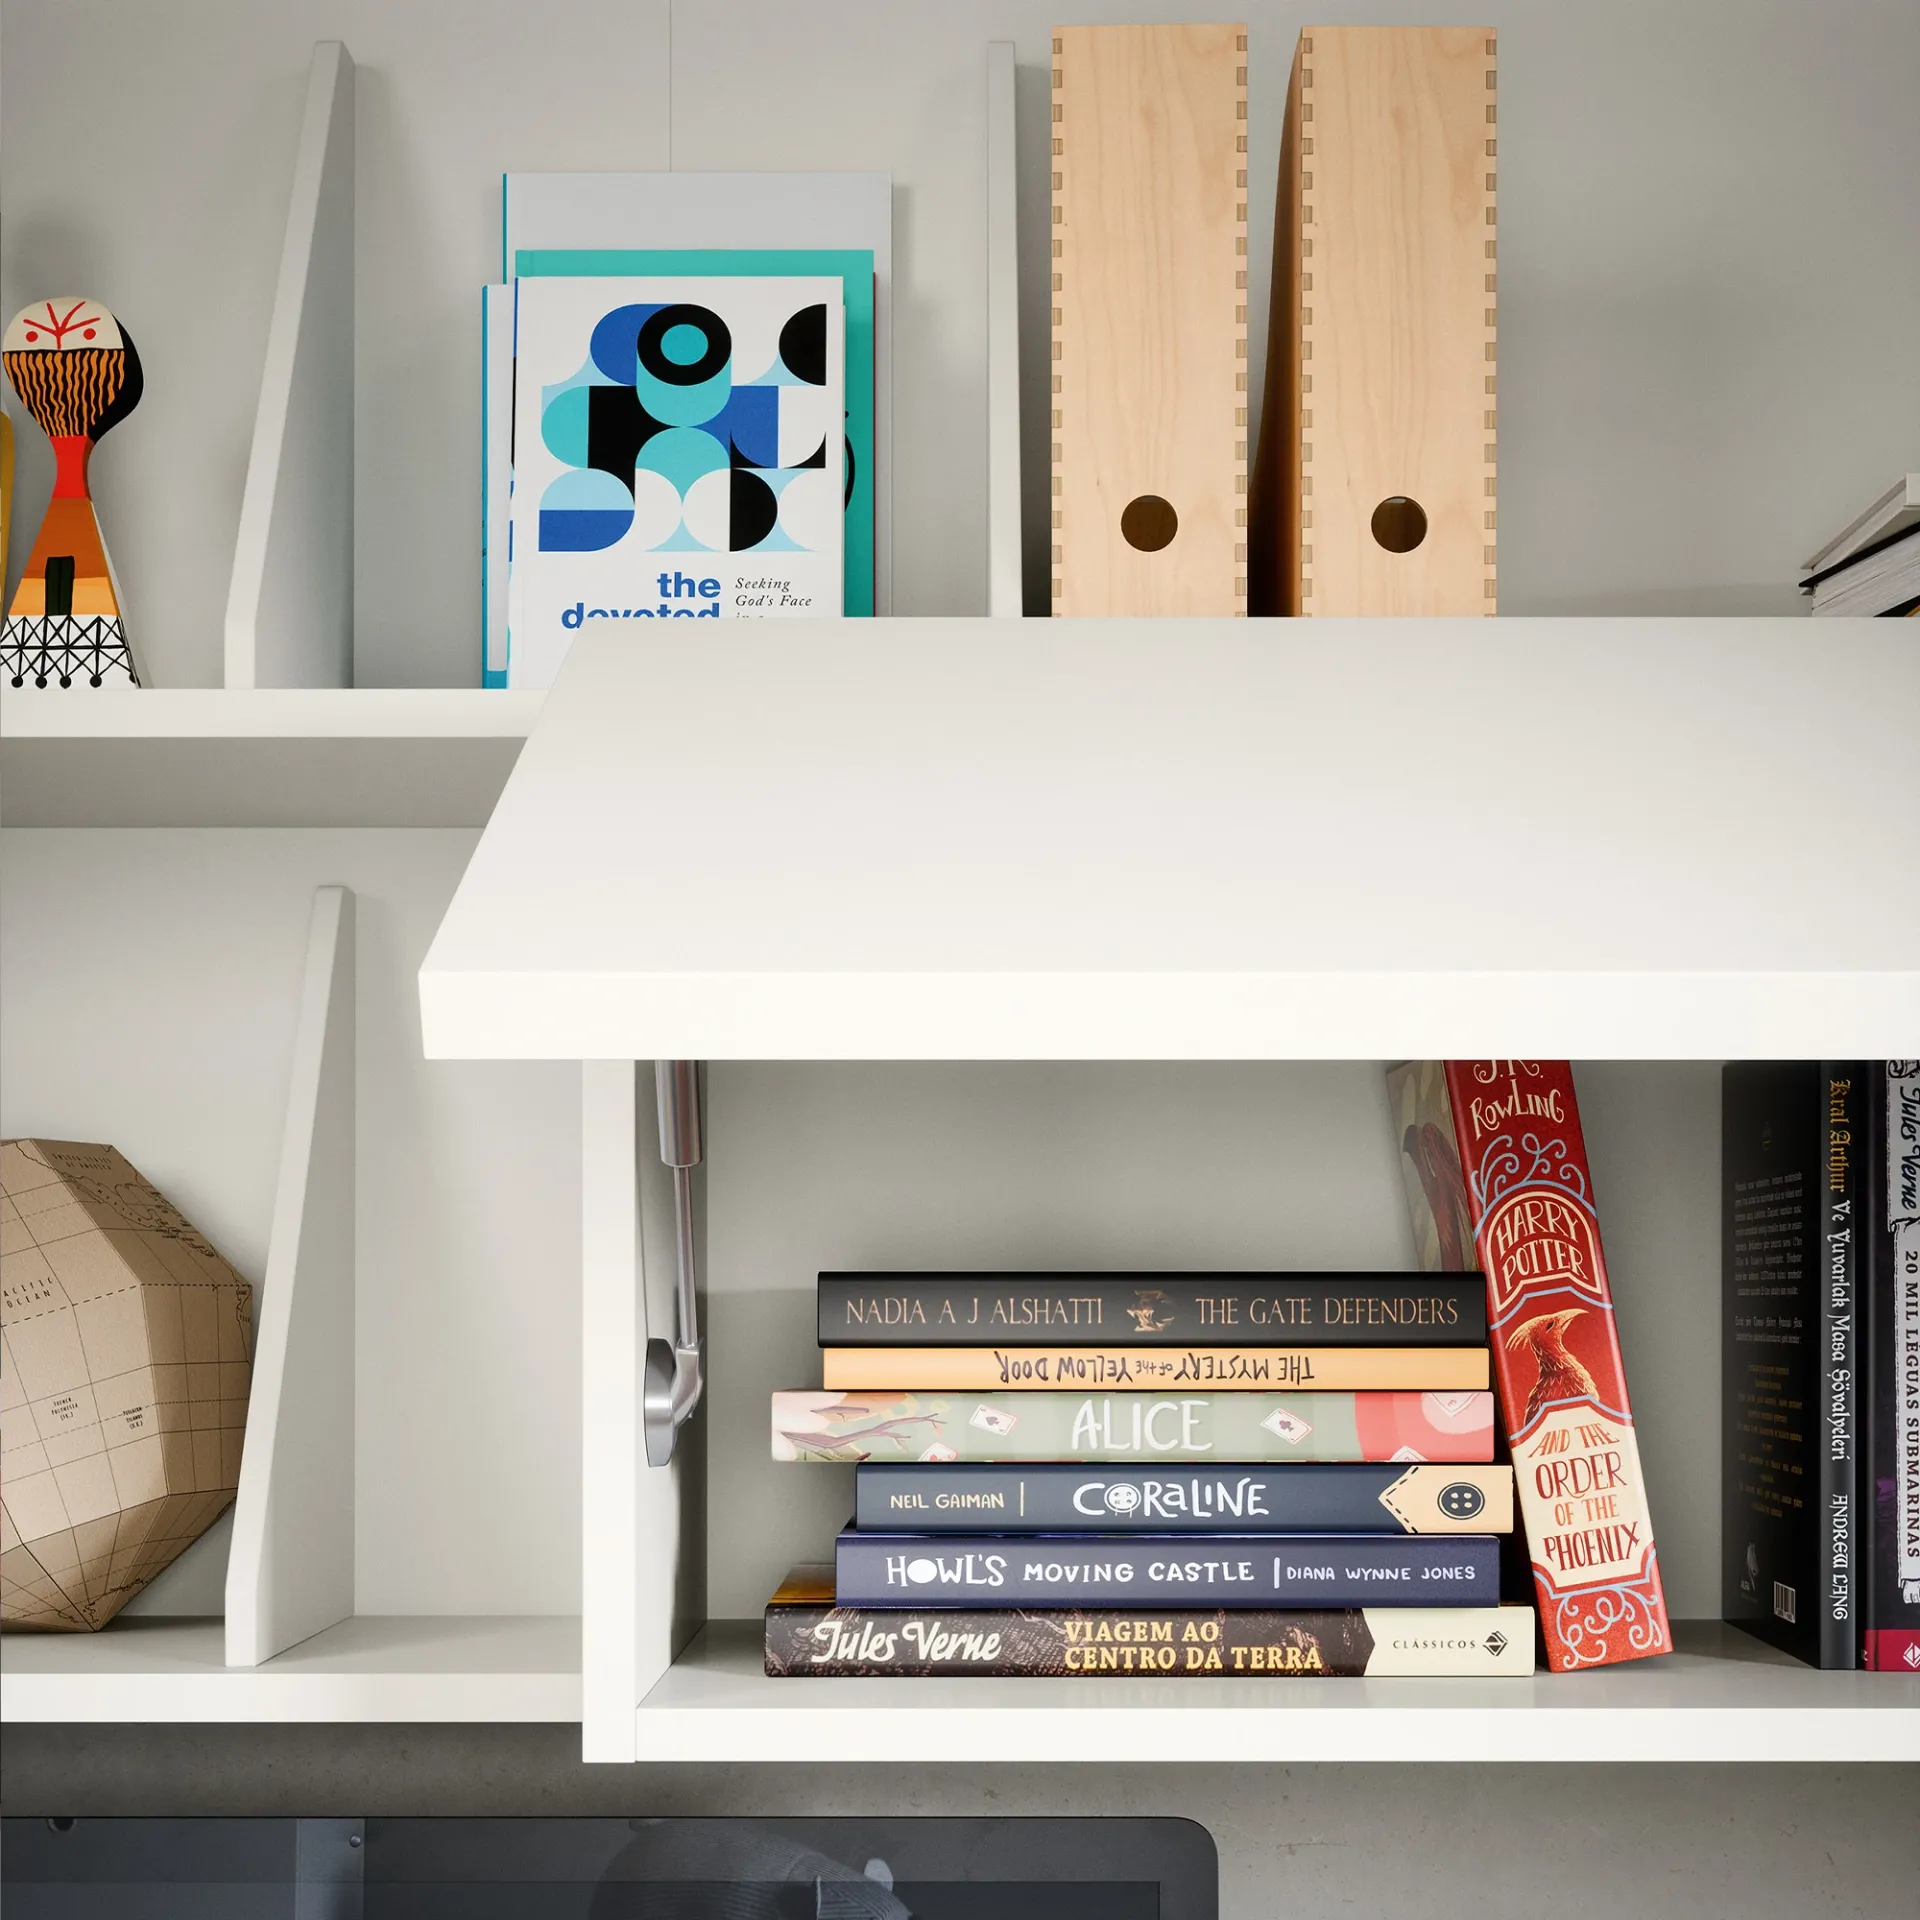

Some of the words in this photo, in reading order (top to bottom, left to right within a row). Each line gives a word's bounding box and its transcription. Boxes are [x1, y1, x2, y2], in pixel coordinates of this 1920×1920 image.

[656, 571, 721, 598] the
[735, 577, 791, 592] Seeking
[735, 594, 774, 606] God's
[780, 594, 812, 606] Face
[1469, 1078, 1565, 1141] ROWLING
[1829, 1079, 1851, 1123] Kral
[1900, 1086, 1920, 1142] Jules
[1826, 1129, 1851, 1193] Arthur
[1902, 1145, 1920, 1210] Verne
[1496, 1200, 1579, 1260] HARRY
[1502, 1238, 1589, 1294] POTTER
[1827, 1228, 1851, 1308] Yuvarlak
[1904, 1250, 1918, 1275] 20
[846, 1298, 927, 1325] NADIA
[938, 1298, 957, 1325] A
[967, 1298, 979, 1325] J
[990, 1298, 1103, 1325] ALSHATTI
[1195, 1298, 1239, 1325] THE
[1250, 1298, 1312, 1325] GATE
[1324, 1298, 1459, 1325] DEFENDERS
[1905, 1282, 1919, 1321] MIL
[1826, 1314, 1851, 1362] Masa
[994, 1351, 1048, 1383] DOOR
[1056, 1355, 1133, 1382] YELLOW
[1174, 1353, 1270, 1382] MYSTERY
[1277, 1355, 1315, 1385] THE
[1071, 1399, 1214, 1451] ALICE
[1826, 1368, 1851, 1461] Şövalyeleri
[1528, 1428, 1570, 1457] AND
[1574, 1423, 1620, 1447] THE
[1535, 1451, 1627, 1499] ORDER
[1905, 1418, 1920, 1558] SUBMARINAS
[890, 1494, 929, 1509] NEIL
[935, 1493, 1005, 1509] GAIMAN
[1554, 1500, 1575, 1526] OF
[1581, 1494, 1620, 1523] THE
[1542, 1521, 1640, 1572] PHOENIX
[1829, 1494, 1849, 1569] ANDREW
[886, 1554, 1008, 1587] HOWL'S
[1023, 1563, 1135, 1582] MOVING
[1148, 1561, 1255, 1582] CASTLE
[1286, 1566, 1336, 1581] DIANA
[1345, 1567, 1412, 1581] WYNNE
[1421, 1566, 1476, 1580] JONES
[1829, 1573, 1849, 1621] LANG
[811, 1621, 898, 1663] Jules
[901, 1621, 1002, 1661] Verne
[1064, 1621, 1173, 1642] VIAGEM
[1181, 1621, 1220, 1642] AO
[1392, 1639, 1476, 1649] CLÁSSICOS
[1064, 1647, 1177, 1670] CENTRO
[1186, 1647, 1223, 1670] DA
[1231, 1647, 1323, 1670] TERRA
